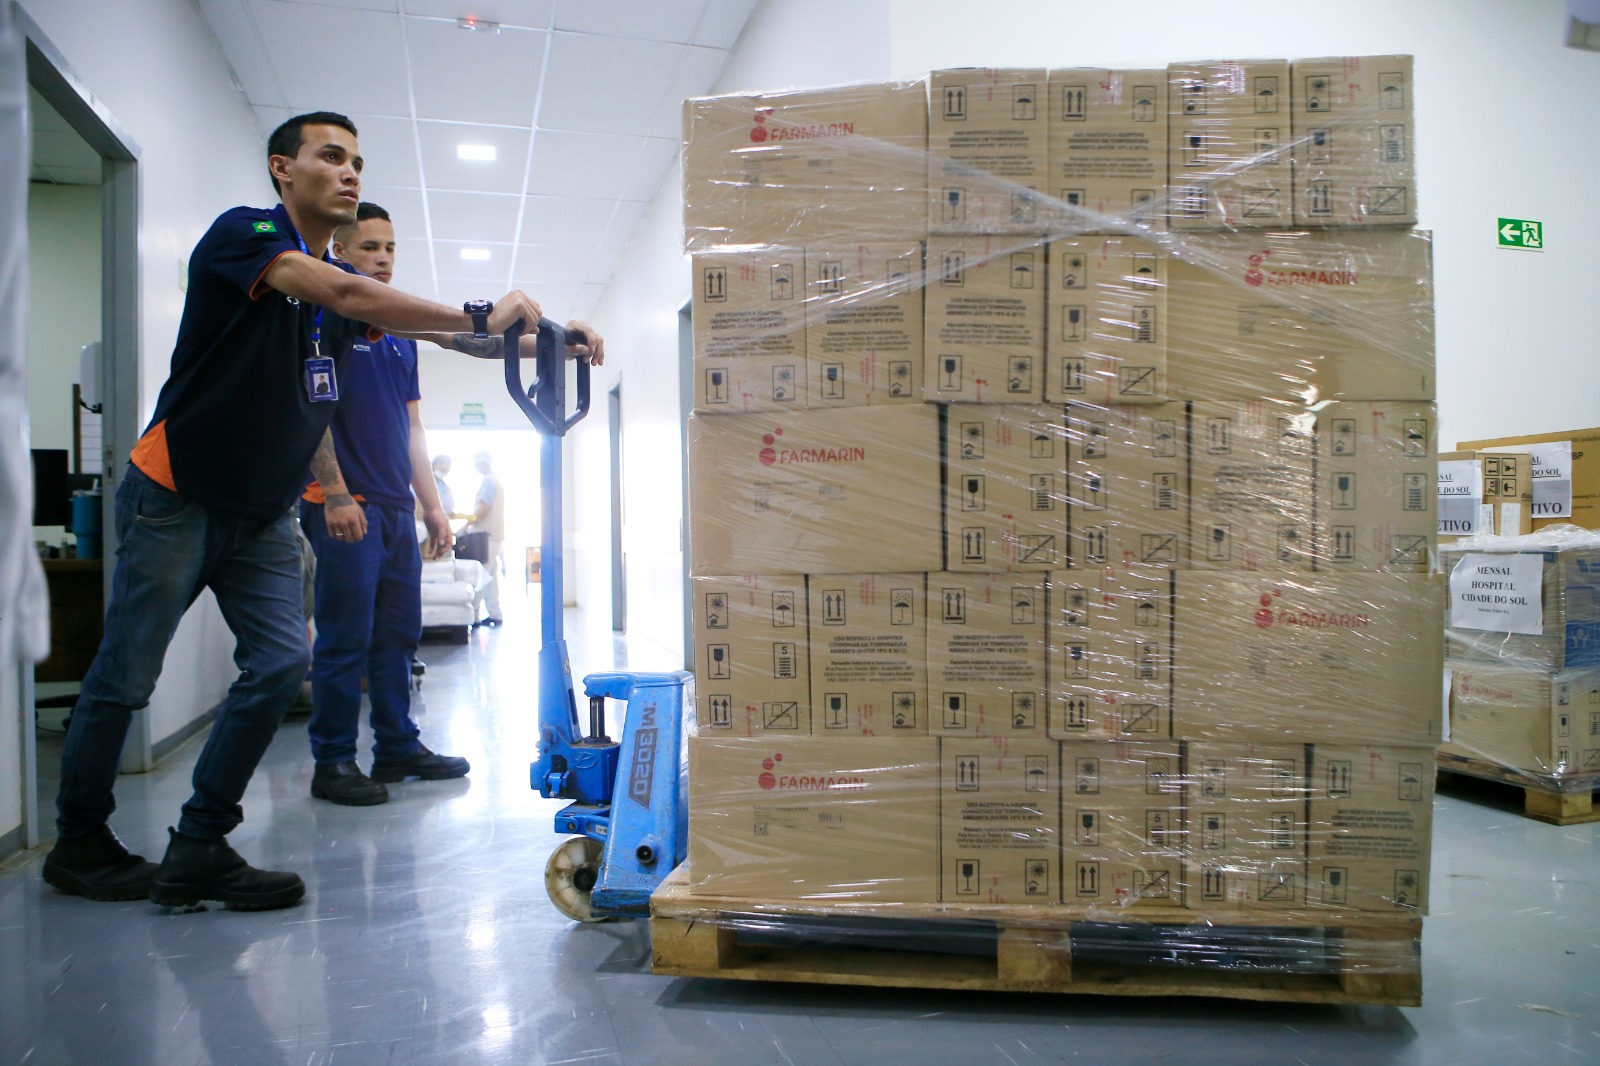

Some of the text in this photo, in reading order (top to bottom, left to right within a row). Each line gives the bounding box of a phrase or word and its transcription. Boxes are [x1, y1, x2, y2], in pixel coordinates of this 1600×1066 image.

[770, 122, 854, 141] FARMARIN
[1268, 271, 1358, 285] FARMARIN
[780, 448, 865, 464] FARMARIN
[1545, 468, 1561, 476] SOL
[1476, 567, 1512, 575] MENSAL
[1472, 581, 1515, 590] HOSPITAL
[1462, 594, 1492, 603] CIDADE
[1509, 597, 1528, 605] SOL
[1278, 612, 1368, 628] FARMARIN
[782, 646, 787, 654] 5
[780, 776, 864, 791] FARMARIN
